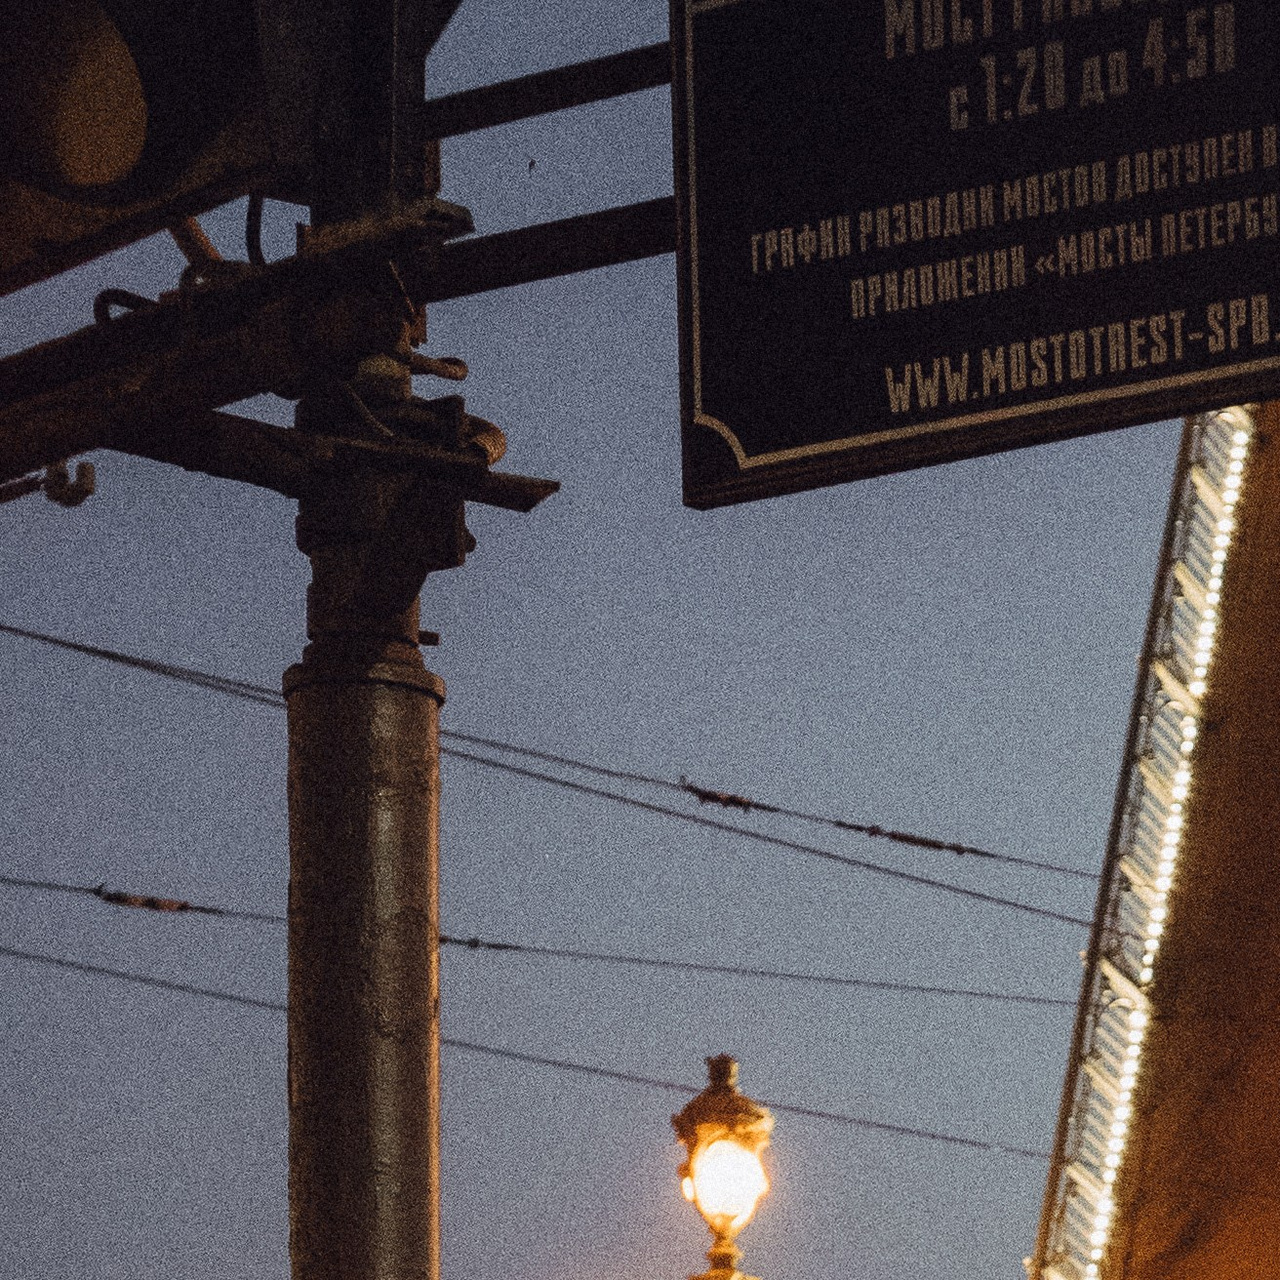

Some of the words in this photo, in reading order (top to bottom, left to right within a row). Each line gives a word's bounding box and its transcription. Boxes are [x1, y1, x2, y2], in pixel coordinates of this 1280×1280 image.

[980, 41, 1066, 123] 1:20
[1079, 50, 1129, 107] до
[1142, 3, 1236, 86] 4:50
[751, 216, 852, 273] ГРАФИК
[1002, 160, 1107, 221] МОСТОВ
[1115, 129, 1253, 201] ДОСТУПЕН
[1262, 125, 1279, 168] В
[850, 245, 1026, 318] ПРИЛОЖЕНИИ
